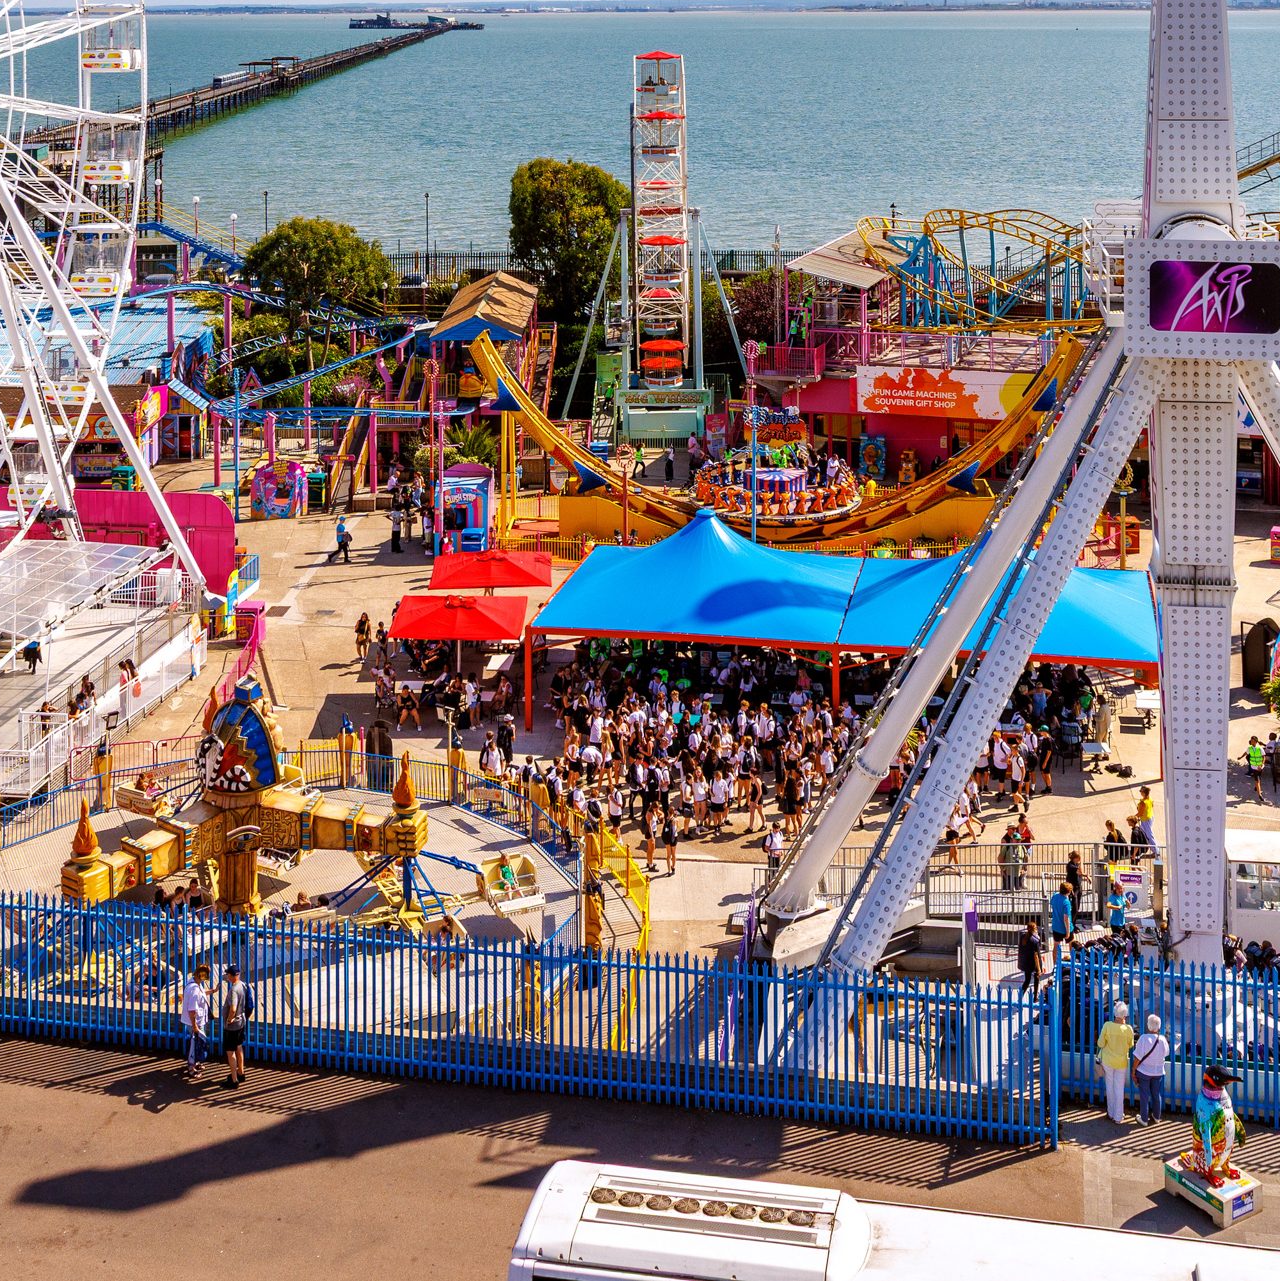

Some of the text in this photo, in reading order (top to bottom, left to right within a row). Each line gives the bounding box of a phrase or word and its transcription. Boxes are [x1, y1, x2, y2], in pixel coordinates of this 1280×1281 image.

[875, 388, 957, 400] FUN GAME MACHINES
[874, 397, 956, 409] SOUVENIR GIFT SHOP
